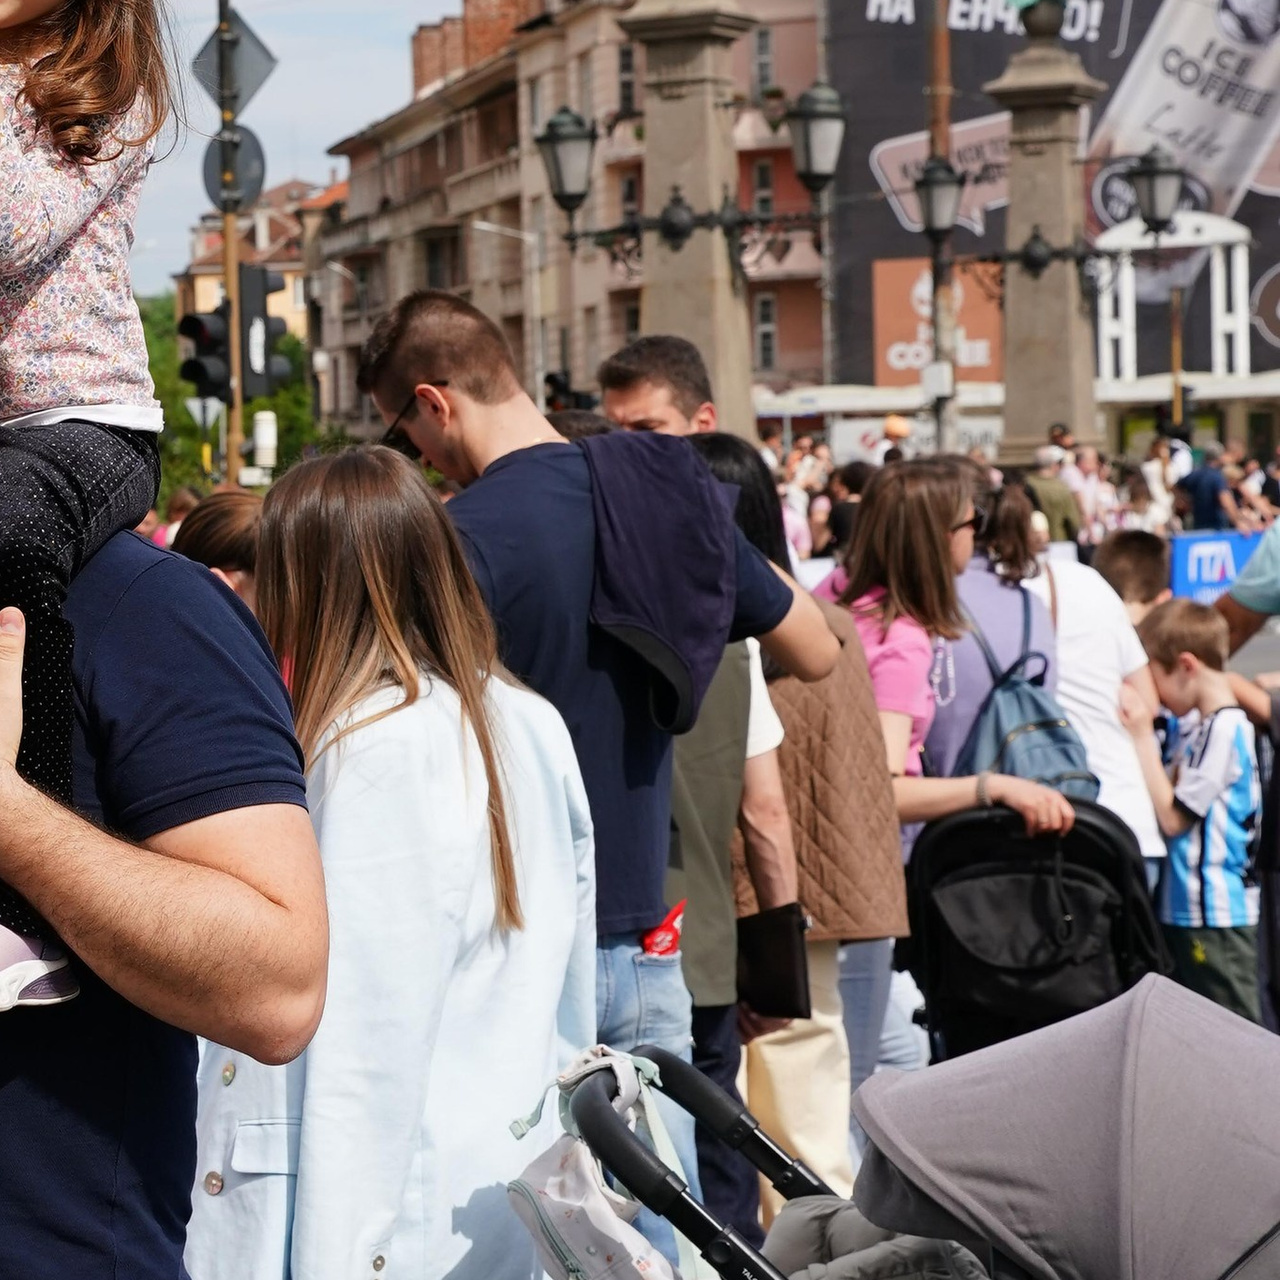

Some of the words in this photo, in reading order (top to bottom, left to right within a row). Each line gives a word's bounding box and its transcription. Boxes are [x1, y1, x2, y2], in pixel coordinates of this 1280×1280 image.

[1201, 39, 1254, 78] ICE
[1161, 45, 1276, 118] COFFEE
[1187, 540, 1237, 583] ITA
